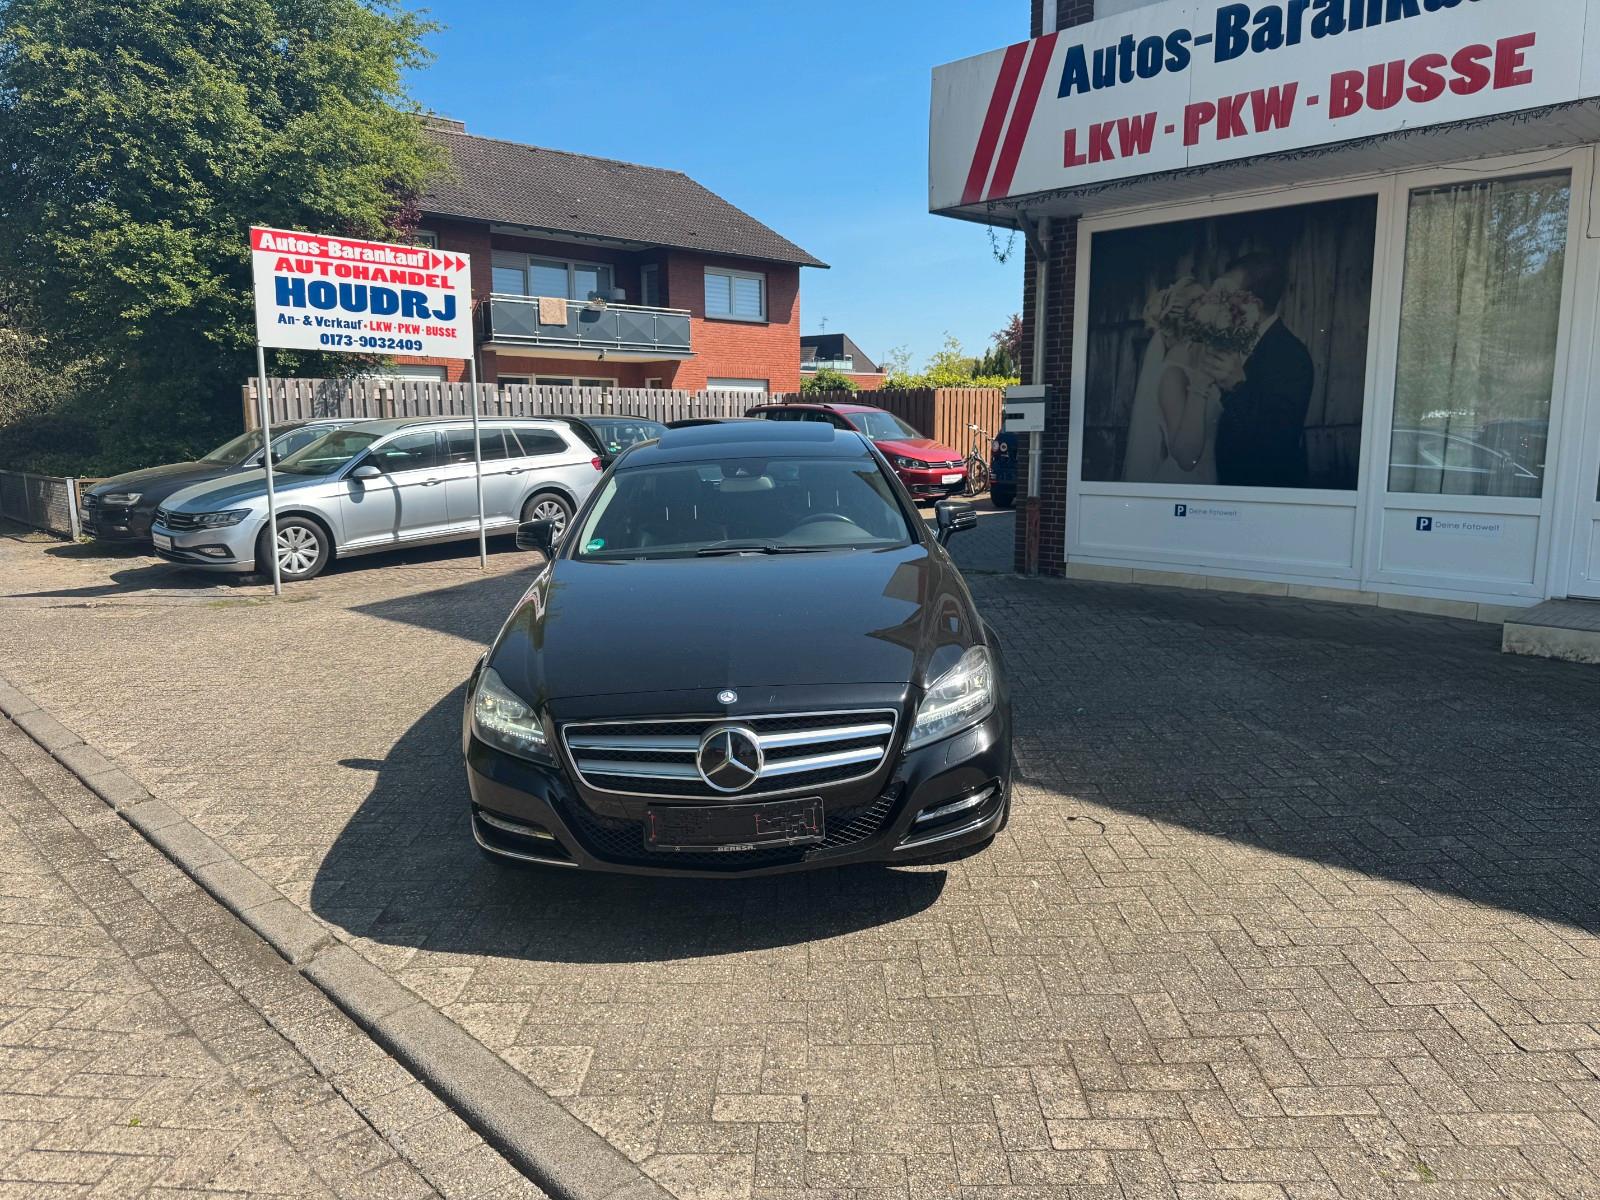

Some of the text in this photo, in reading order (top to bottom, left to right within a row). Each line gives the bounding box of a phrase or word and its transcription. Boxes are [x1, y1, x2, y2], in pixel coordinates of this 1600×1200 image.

[1064, 112, 1157, 168] LKW
[1183, 82, 1299, 146] PKW
[1329, 32, 1536, 119] BUSSE
[259, 233, 426, 269] Autos-Barankauf
[274, 257, 456, 290] AUTOHANDEL
[274, 276, 457, 321] HOUDRJ
[277, 313, 457, 338] An- & Verkauf LKW PKW BUSSE
[320, 333, 423, 351] 0173-9032409
[1435, 521, 1460, 530] Deine
